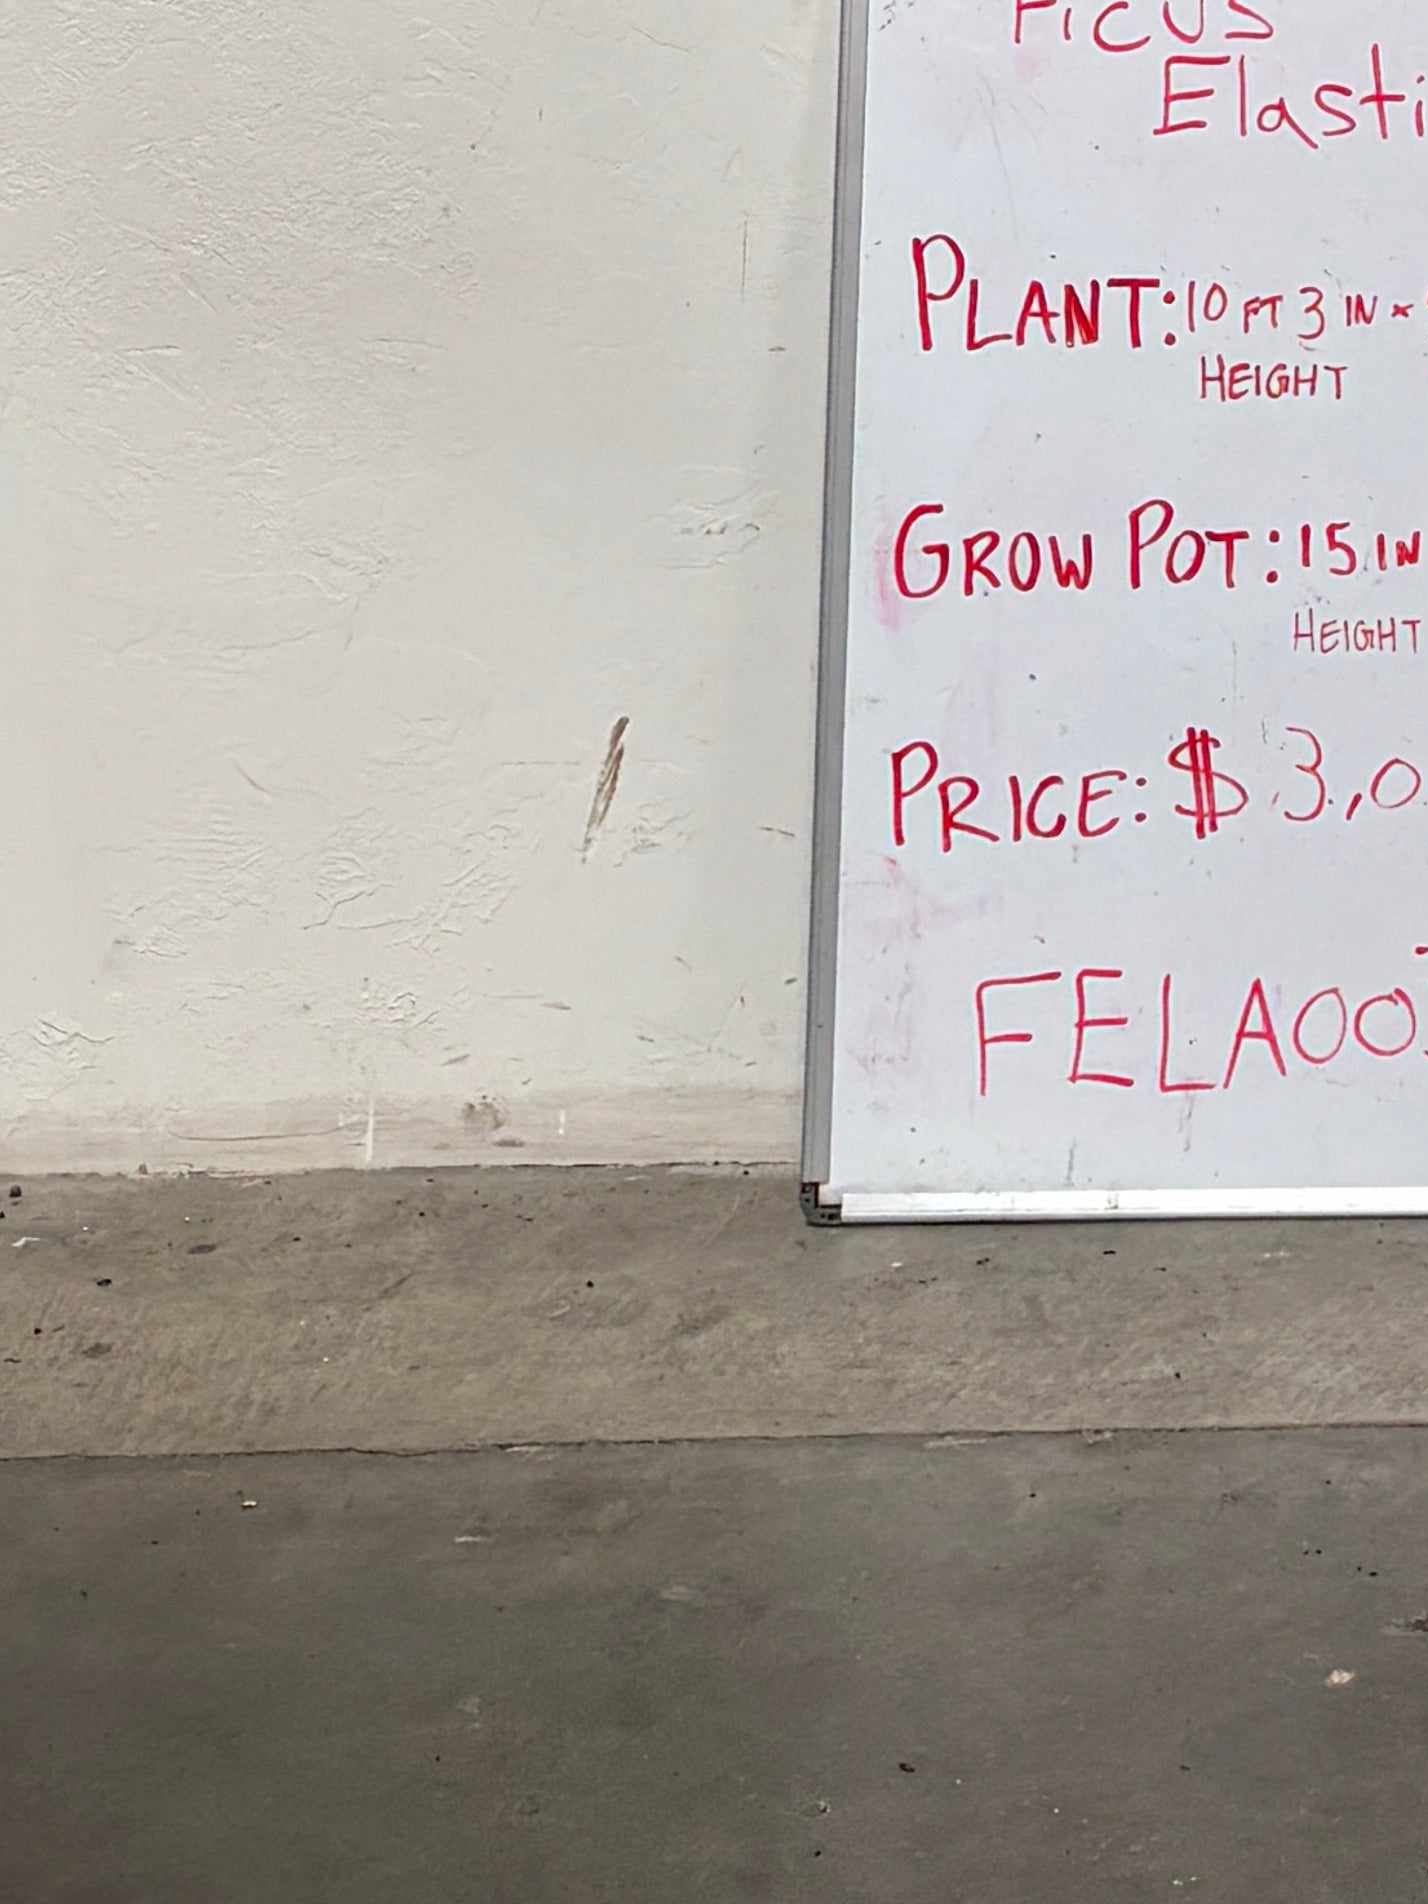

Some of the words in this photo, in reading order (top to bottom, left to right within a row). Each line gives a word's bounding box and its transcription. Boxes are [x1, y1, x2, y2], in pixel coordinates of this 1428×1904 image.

[1243, 294, 1283, 334] FT
[1300, 286, 1325, 341] 3
[1344, 293, 1375, 326] IN
[1200, 354, 1348, 402] HEIGHT
[892, 503, 1093, 600] GROW
[1299, 521, 1357, 577] 15
[1375, 530, 1421, 572] IN
[1292, 607, 1421, 654] HEIGHT
[890, 741, 1148, 854] PRICE:
